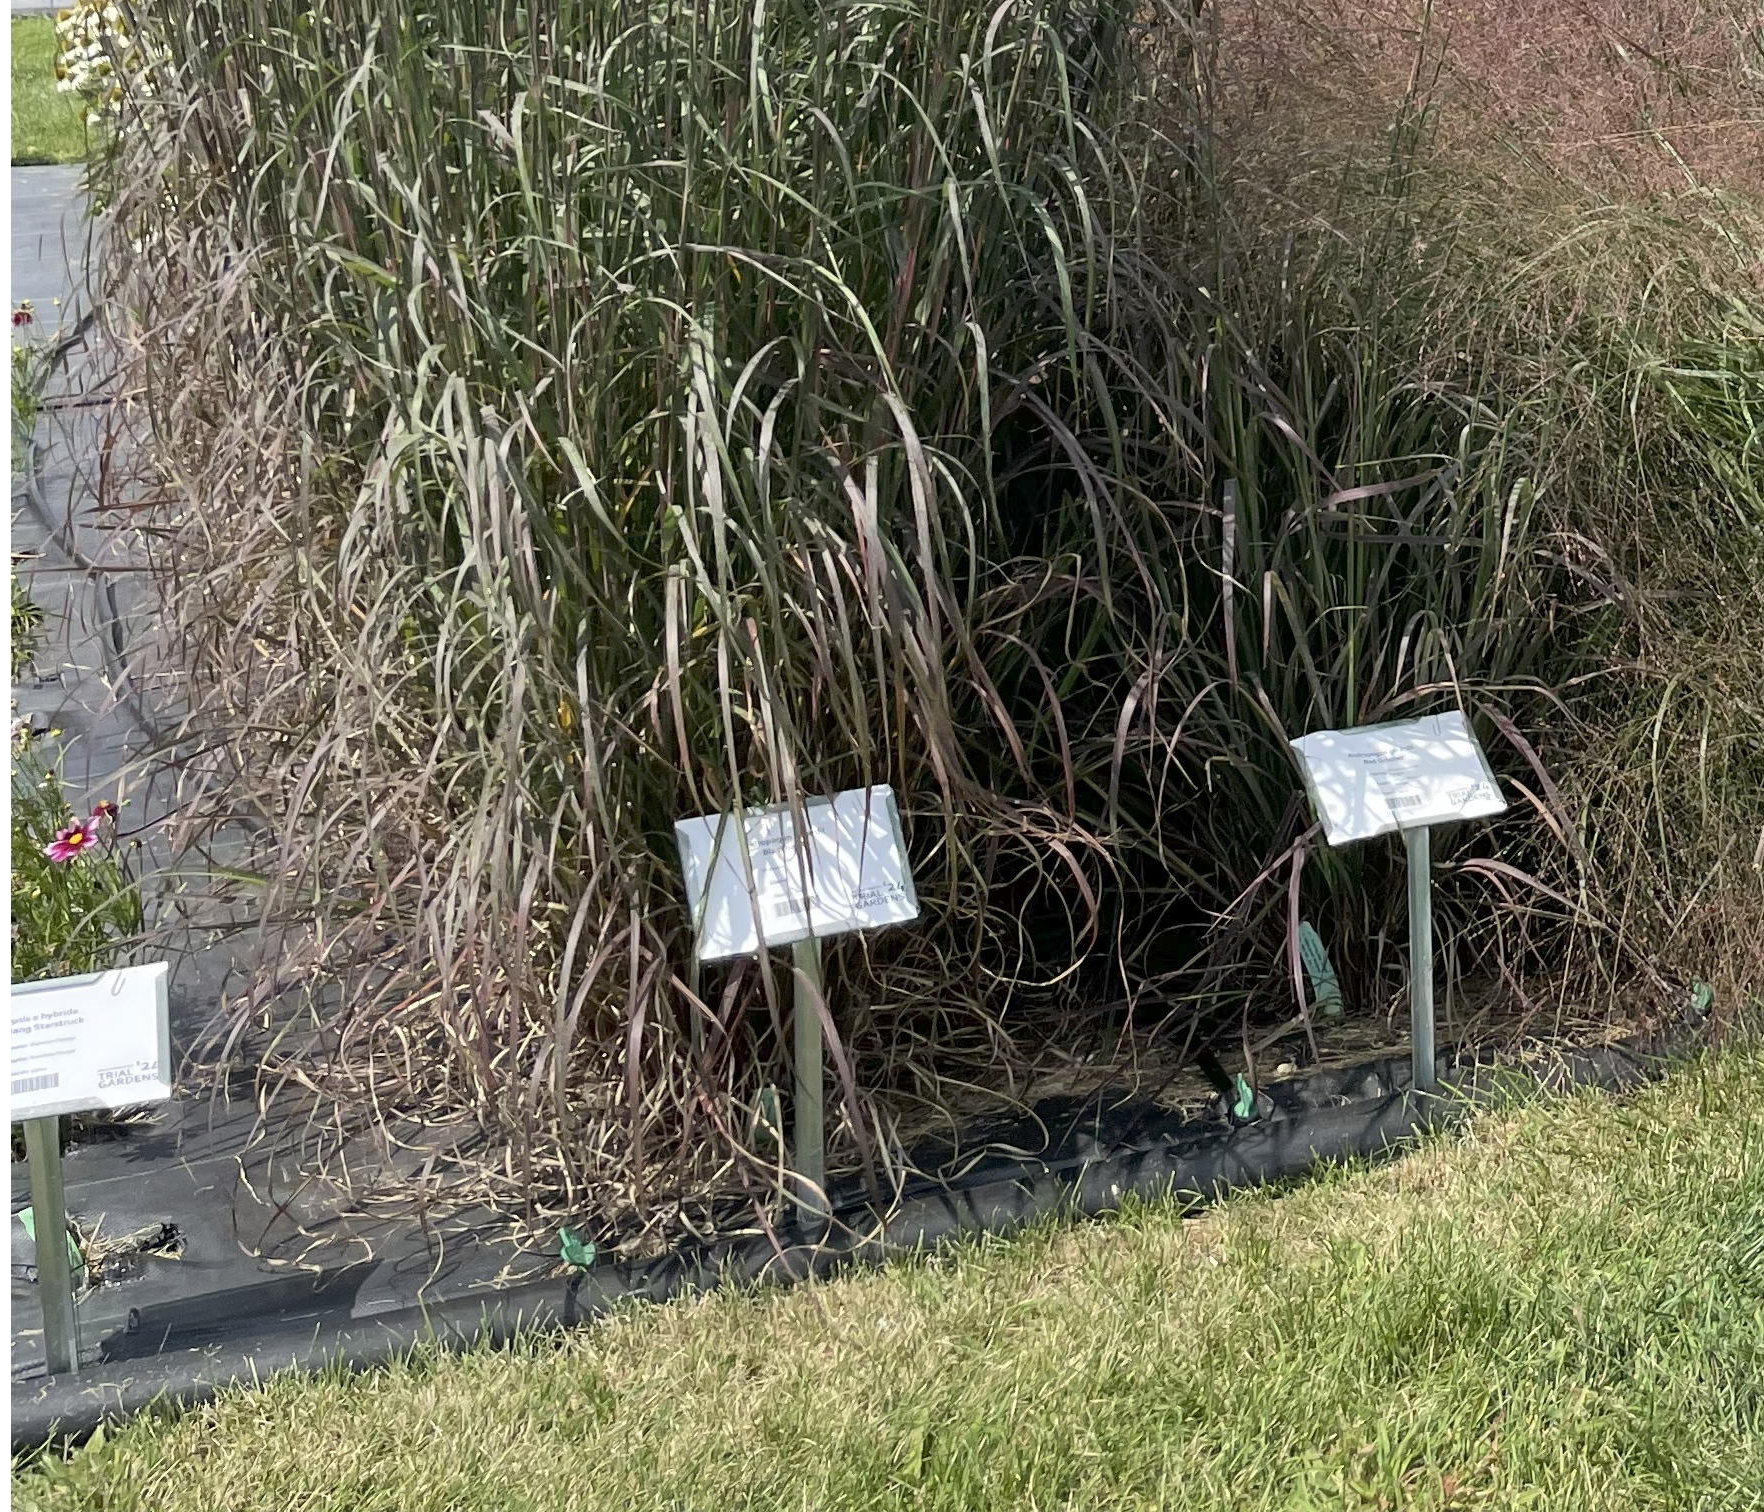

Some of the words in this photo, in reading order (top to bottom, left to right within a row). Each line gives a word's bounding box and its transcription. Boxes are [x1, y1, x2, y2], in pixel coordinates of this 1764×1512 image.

[855, 893, 906, 909] GARDENS
[98, 1068, 134, 1081] TRIAL
[98, 1071, 159, 1089] GARDENS
